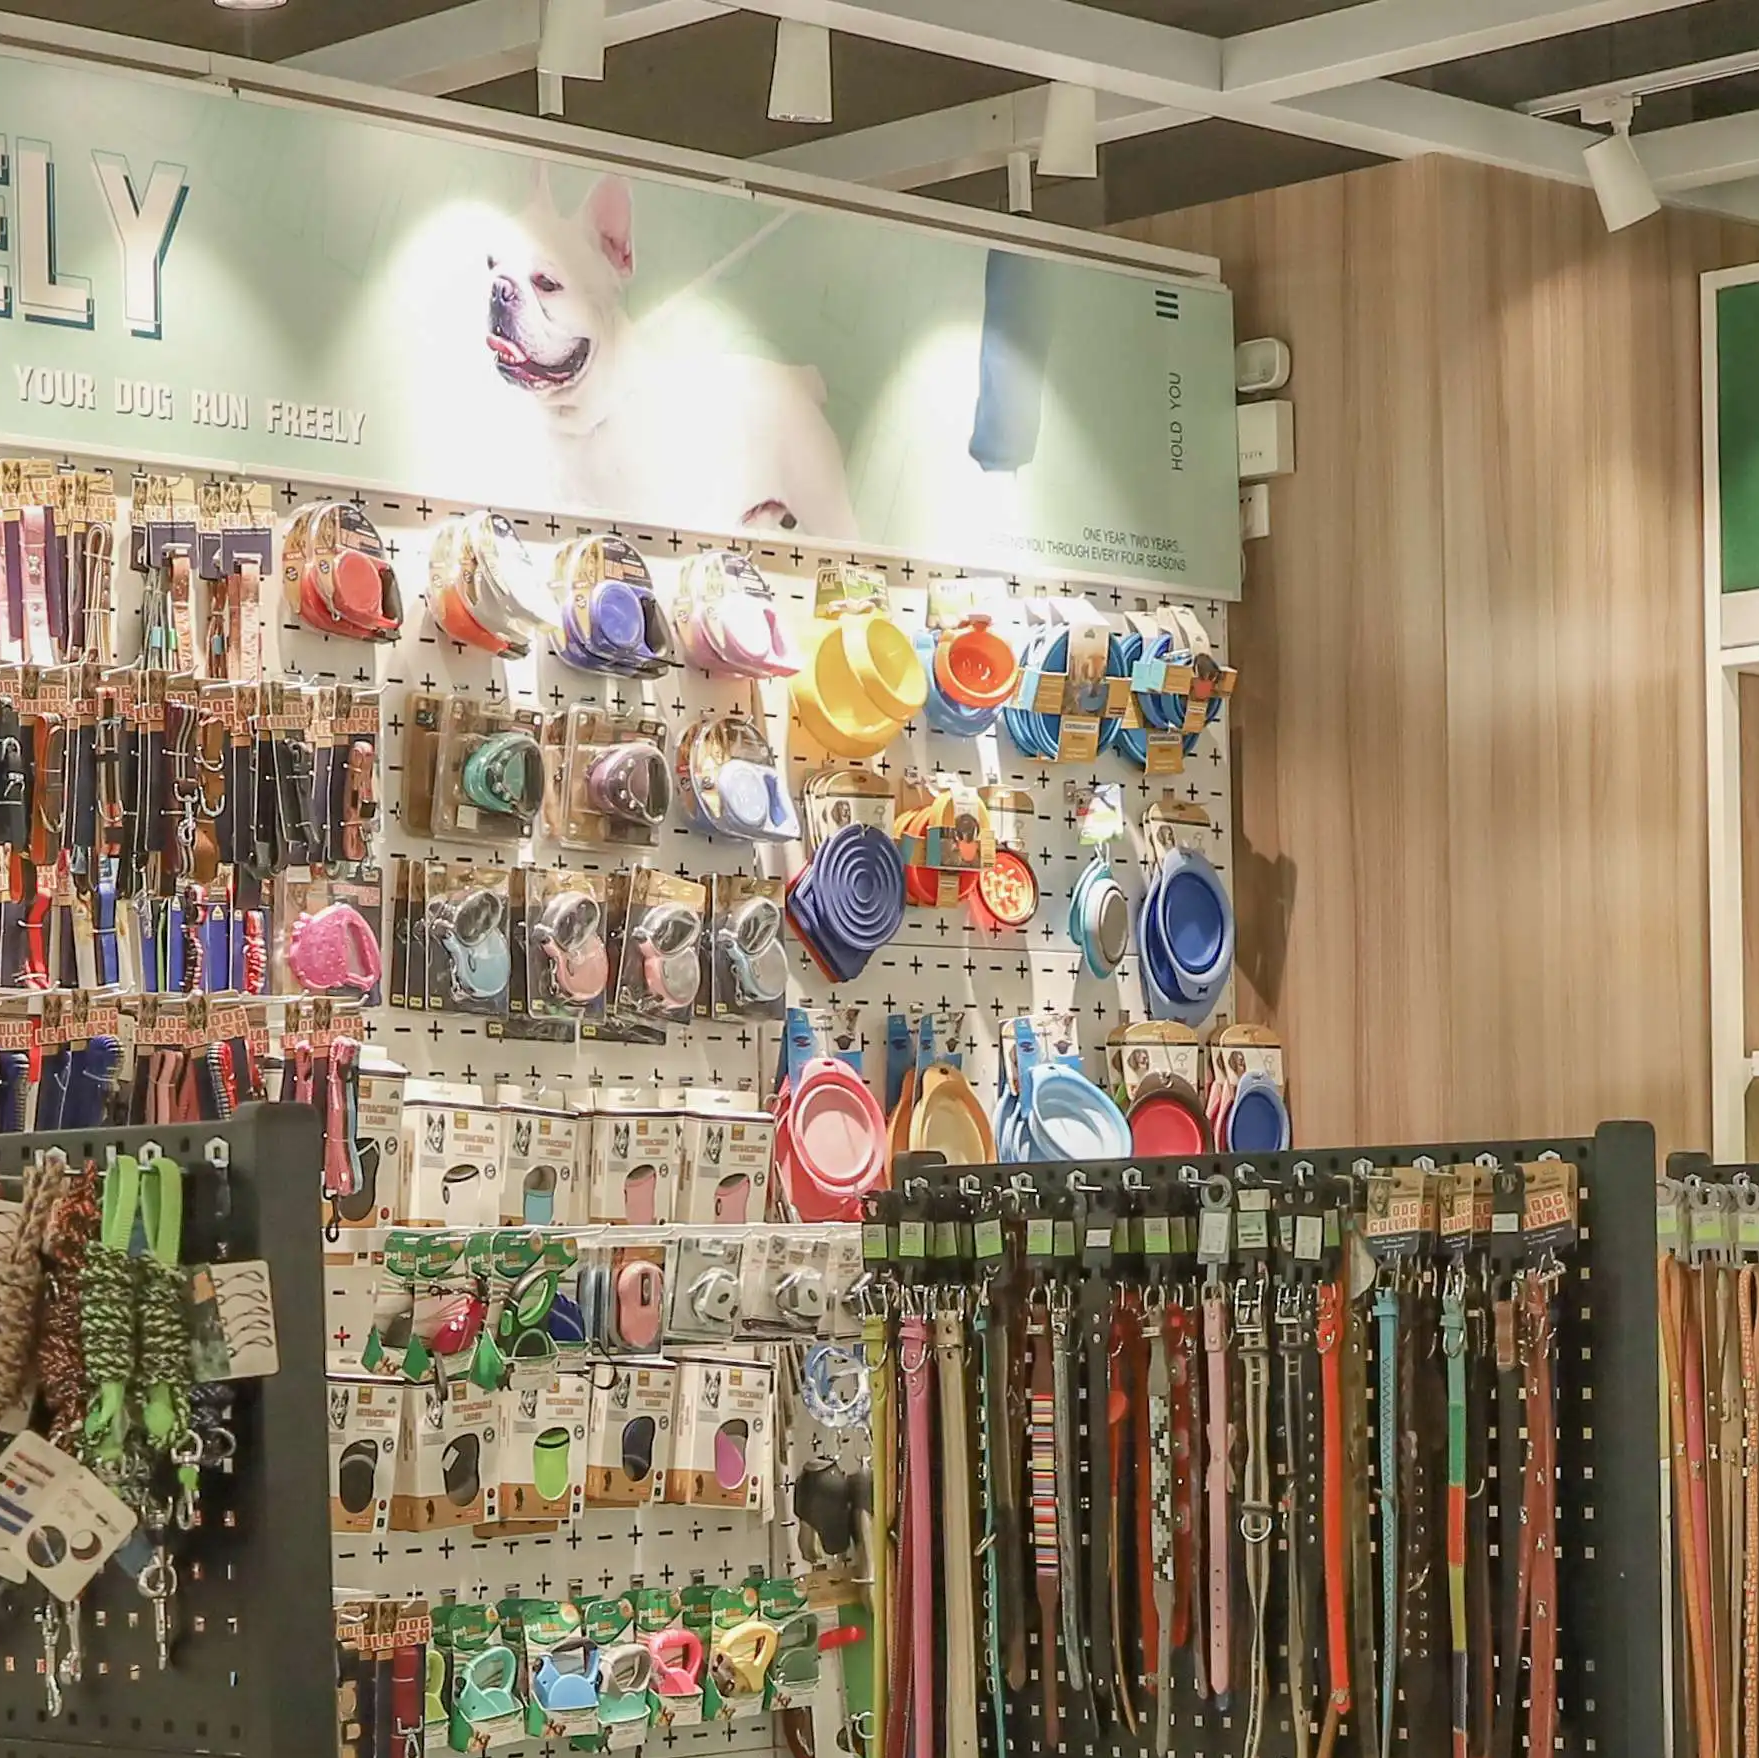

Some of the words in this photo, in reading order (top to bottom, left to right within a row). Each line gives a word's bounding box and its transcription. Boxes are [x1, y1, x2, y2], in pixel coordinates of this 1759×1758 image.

[1169, 372, 1181, 409] YOU
[12, 363, 97, 411] YOUR
[114, 378, 174, 420] DOG
[190, 390, 250, 430] RUN
[265, 398, 367, 446] FREELY
[1170, 421, 1183, 472] HOLD
[1083, 526, 1101, 541] ONE
[1130, 533, 1150, 549] TWO
[1047, 540, 1090, 560] THROUGH
[1091, 547, 1120, 564] EVERY
[1121, 551, 1144, 567] FOUR
[1146, 554, 1187, 573] SEASONS
[87, 1006, 118, 1023] DOG
[158, 1015, 187, 1030] DOG
[209, 1007, 248, 1029] DOG
[68, 1020, 119, 1038] LEASH
[135, 1028, 187, 1044] LEASH
[185, 1023, 248, 1046] LEASH
[1386, 1204, 1418, 1218] DOG
[1368, 1216, 1420, 1234] COLLAR
[397, 1617, 431, 1633] DOG
